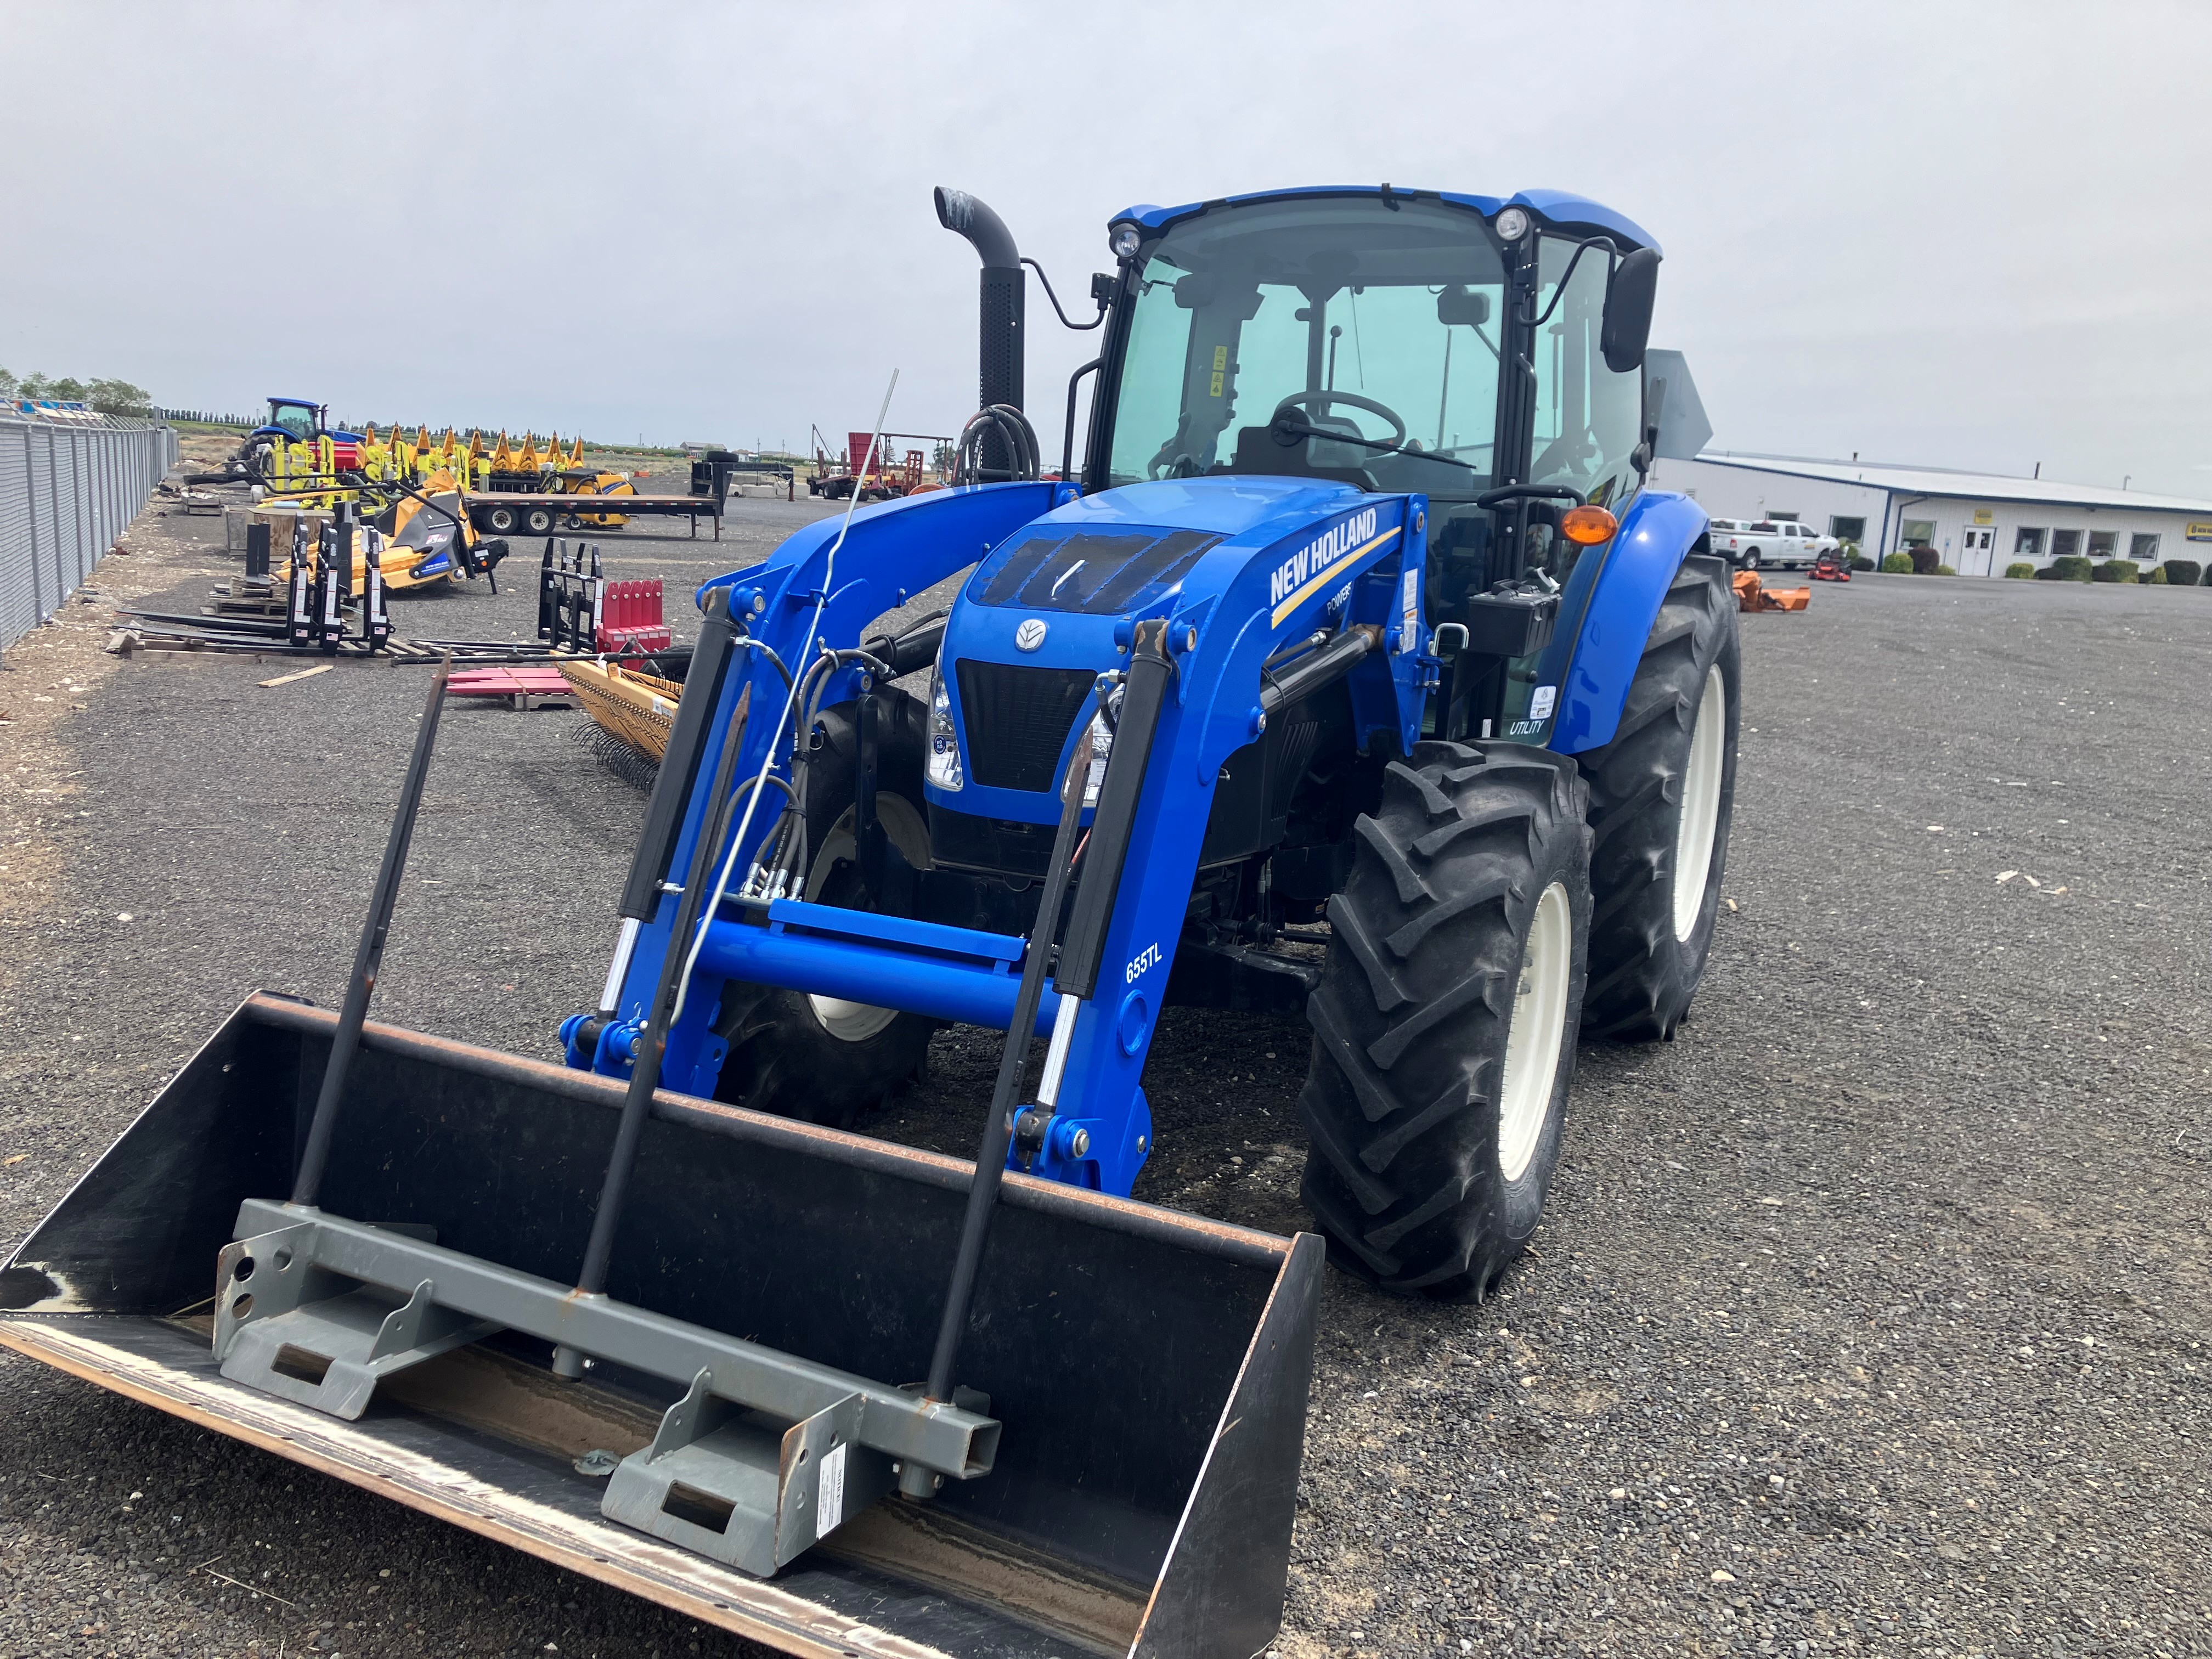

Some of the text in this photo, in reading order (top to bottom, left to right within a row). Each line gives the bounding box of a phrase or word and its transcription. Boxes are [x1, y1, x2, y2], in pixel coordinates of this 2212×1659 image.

[1271, 507, 1376, 606] NEW HOLLAND
[1509, 720, 1545, 736] UTILITY
[1126, 942, 1163, 984] 655TL
